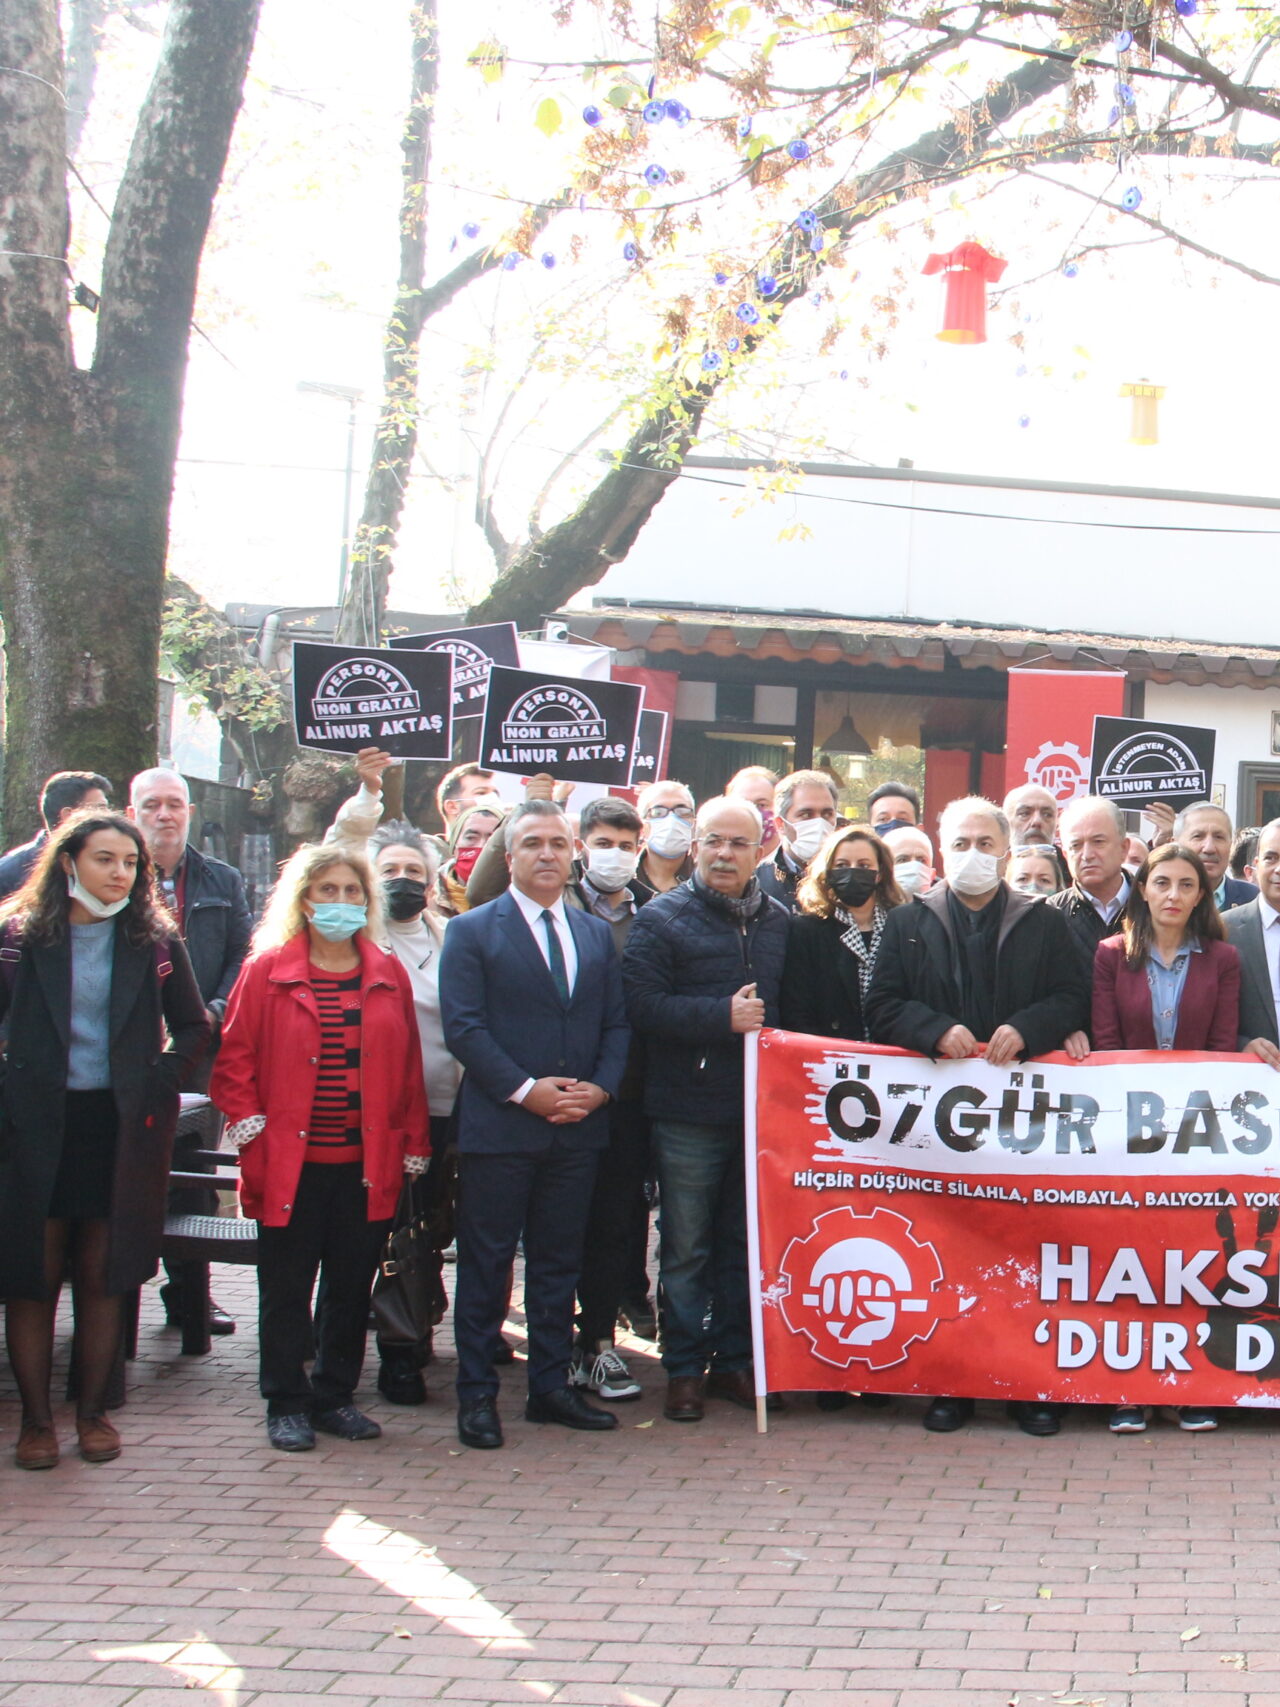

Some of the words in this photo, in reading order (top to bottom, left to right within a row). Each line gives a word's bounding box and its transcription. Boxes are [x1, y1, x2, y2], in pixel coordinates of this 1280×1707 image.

[436, 644, 477, 663] SONA
[325, 663, 400, 698] PERSONA
[316, 702, 352, 716] NON
[358, 697, 415, 713] GRATA
[517, 690, 590, 721] PERSONA
[305, 721, 372, 740] ALİNUR
[380, 714, 443, 734] AKTAŞ
[507, 726, 541, 739] NON
[548, 725, 600, 738] GRATA
[490, 745, 558, 763] ALİNUR
[566, 744, 626, 762] AKTAŞ
[1111, 742, 1164, 774] İSTENMEYEN
[1166, 747, 1187, 771] ADAM
[1101, 778, 1153, 794] ALİNUR
[1158, 777, 1200, 790] AKTAŞ
[825, 1063, 1100, 1155] ÖZGÜR
[794, 1169, 854, 1191] HİÇBİR
[860, 1171, 943, 1194] DÜŞÜNCE
[947, 1178, 1028, 1204] SİLAHLA,
[1033, 1188, 1140, 1209] BOMBAYLA,
[1145, 1191, 1238, 1207] BALYOZLA
[1243, 1191, 1280, 1207] YOK
